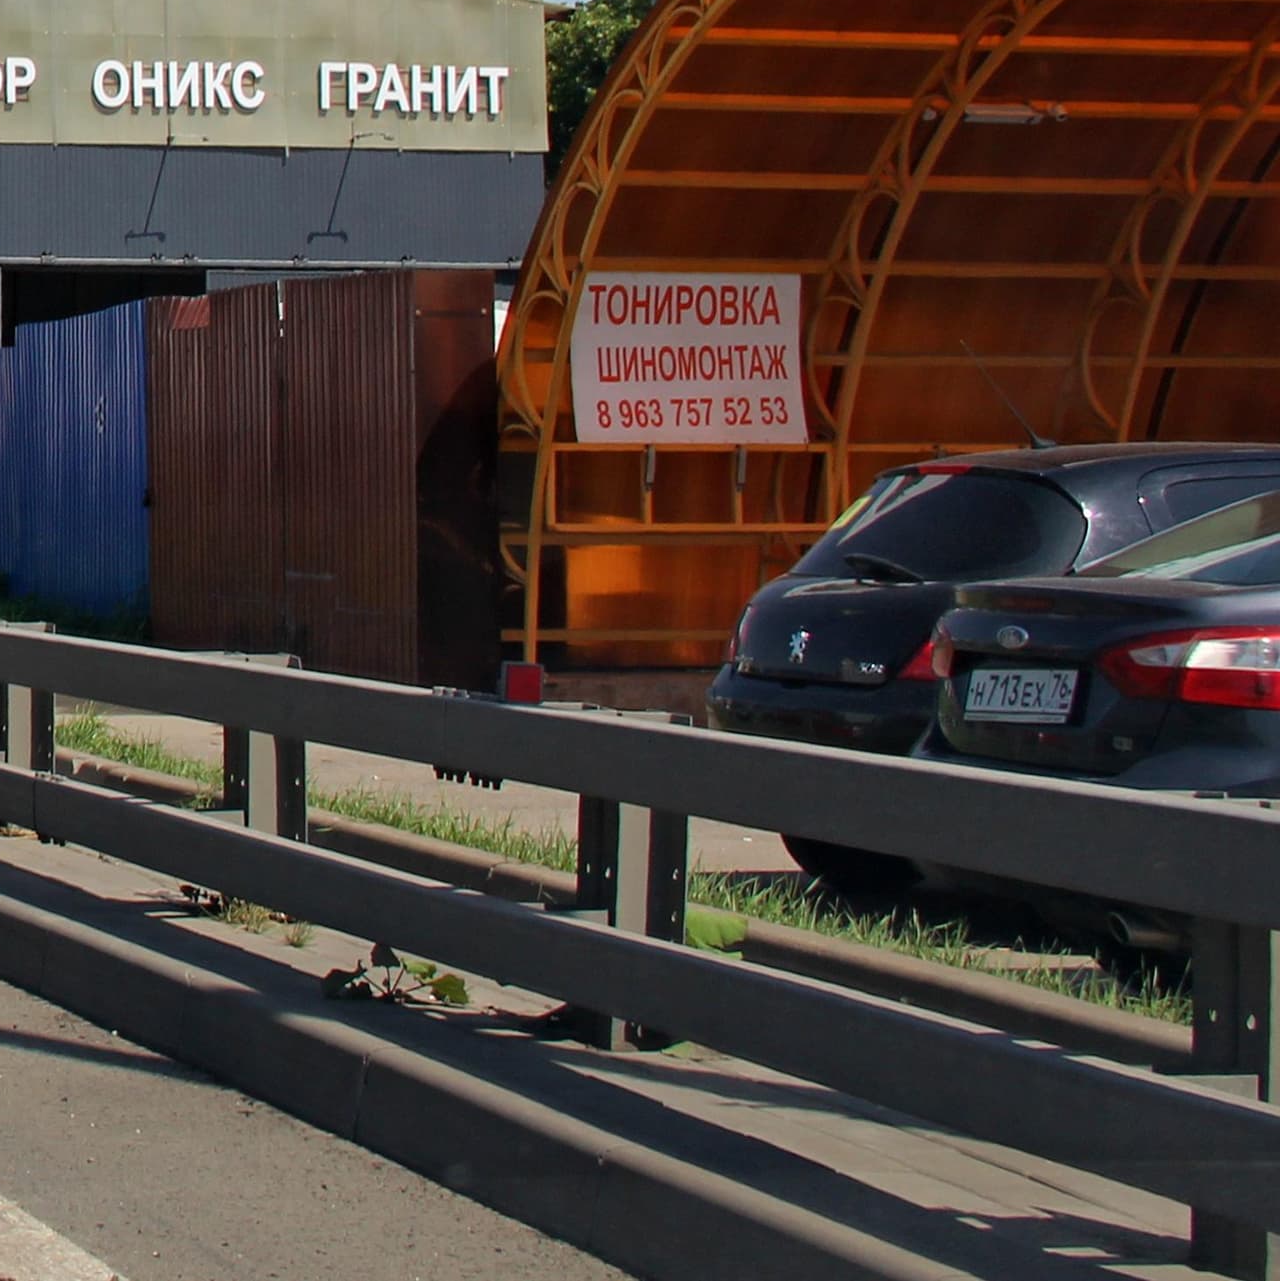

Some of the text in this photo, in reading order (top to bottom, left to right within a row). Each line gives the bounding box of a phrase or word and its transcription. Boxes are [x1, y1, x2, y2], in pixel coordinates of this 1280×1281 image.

[92, 59, 267, 111] ОНИКС
[317, 61, 509, 115] ГРАНИТ
[589, 284, 781, 326] ТОНИРОВКА
[597, 345, 788, 383] ШИНОМОНТАЖ
[597, 396, 789, 428] 8 963 757 52 53
